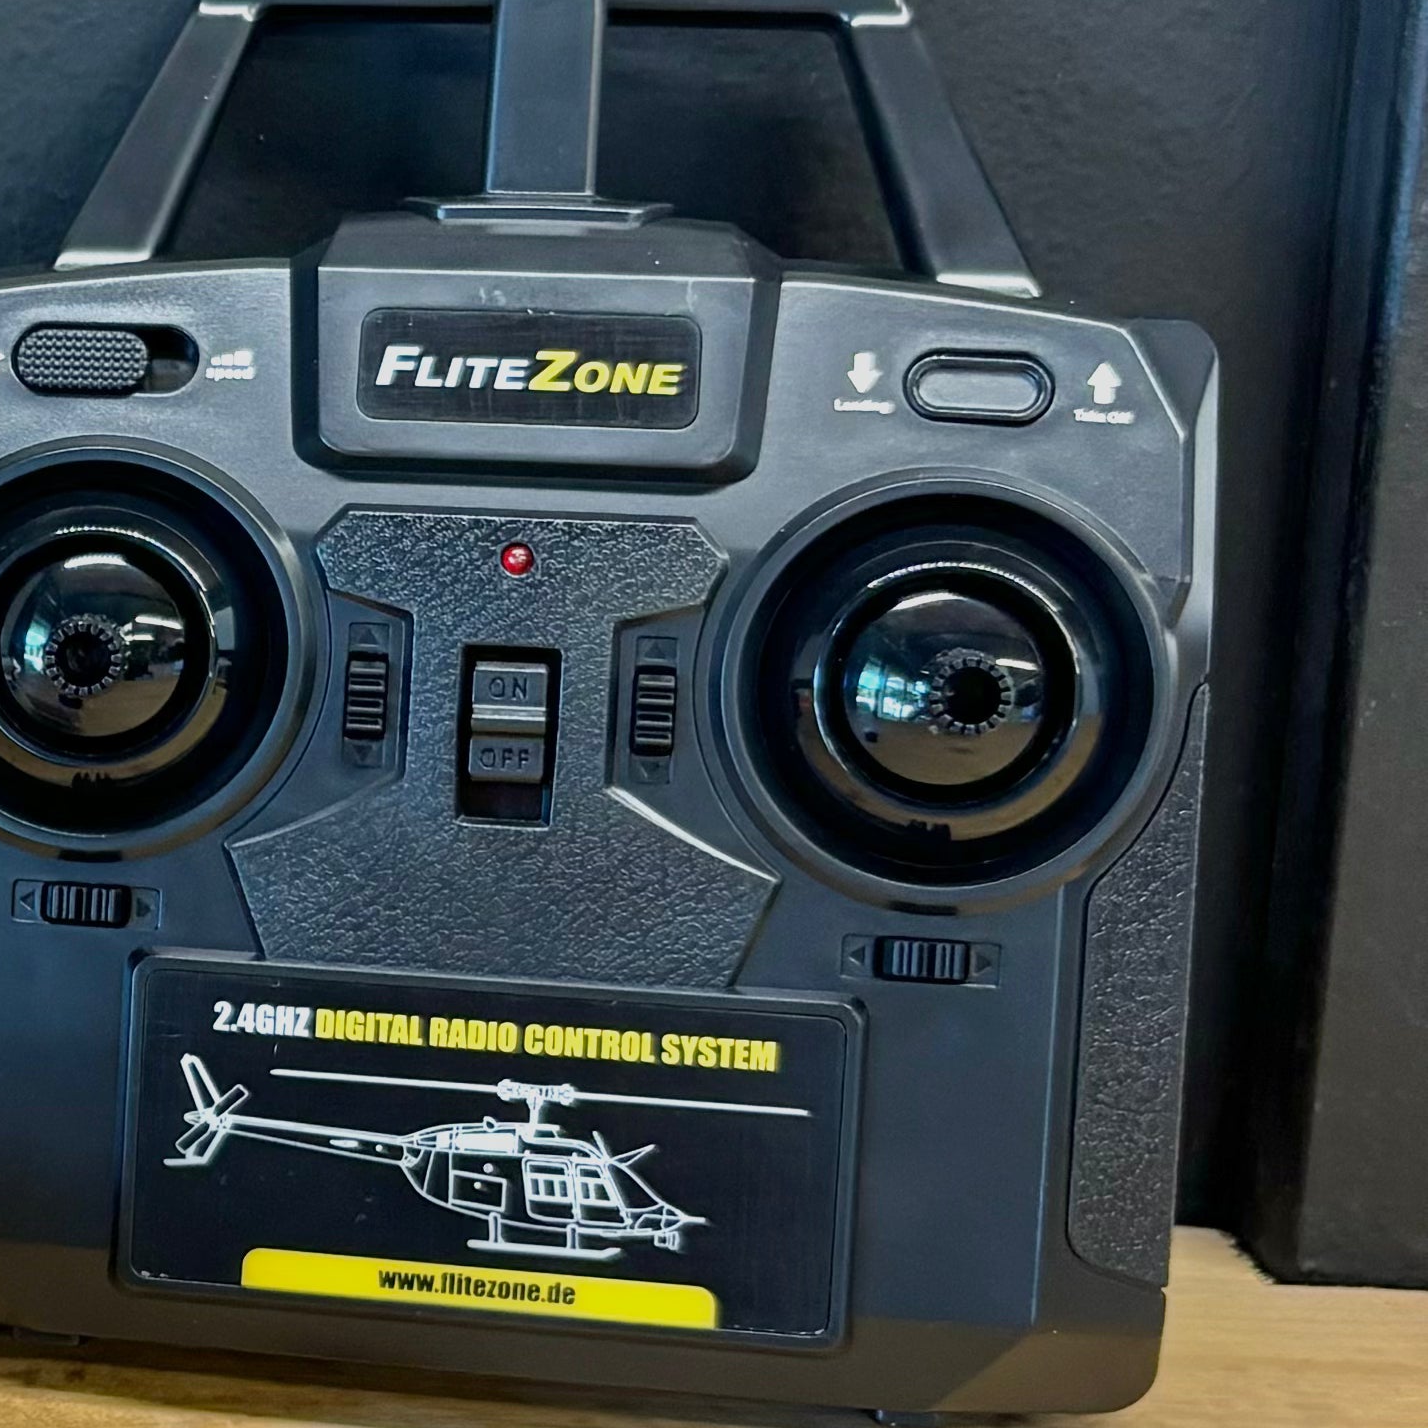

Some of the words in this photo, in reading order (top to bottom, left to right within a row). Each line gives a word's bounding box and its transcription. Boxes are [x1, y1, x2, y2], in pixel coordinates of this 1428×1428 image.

[375, 344, 684, 397] FLITEZONE
[488, 677, 528, 701] ON
[478, 746, 530, 769] OFF
[212, 1000, 312, 1038] 2.4GHZ
[315, 1008, 424, 1047] DIGITAL
[428, 1019, 518, 1053] RADIO
[524, 1026, 655, 1065] CONTROL
[660, 1034, 781, 1073] SYSTEM
[378, 1269, 577, 1305] www.flitezone.de
